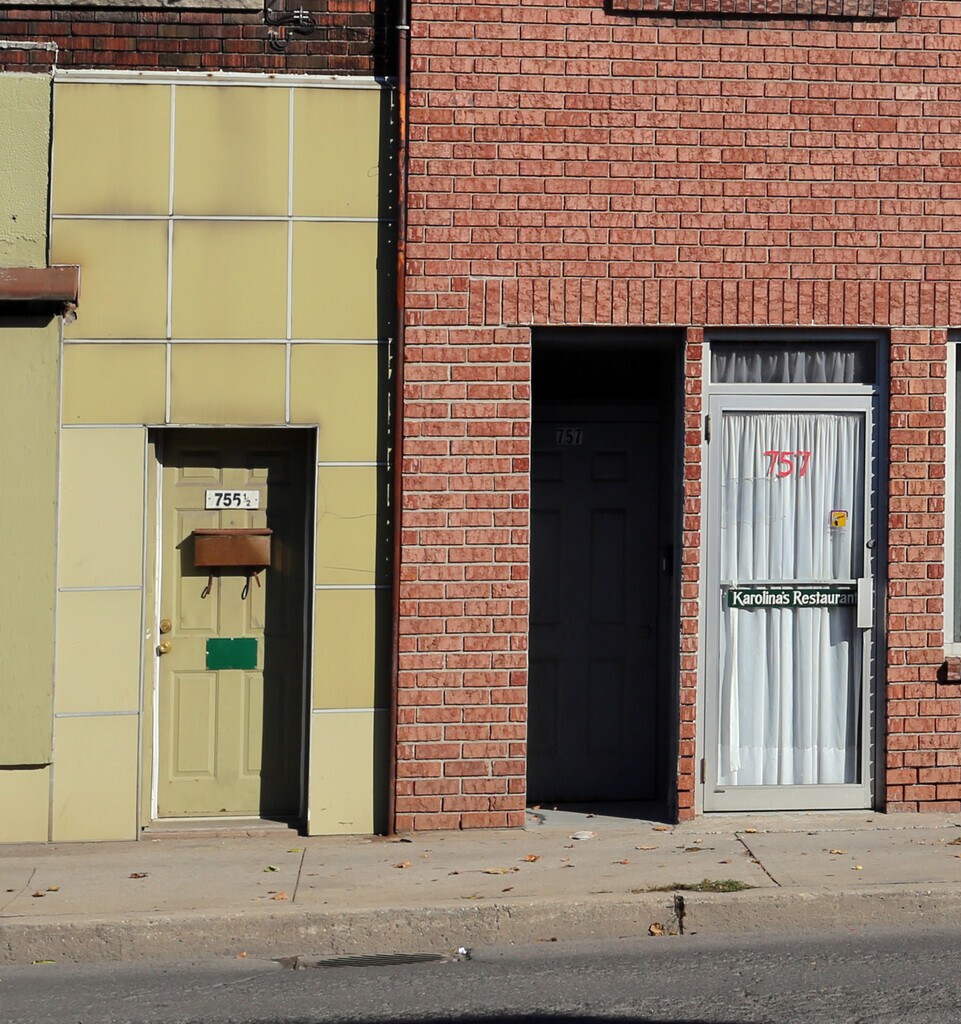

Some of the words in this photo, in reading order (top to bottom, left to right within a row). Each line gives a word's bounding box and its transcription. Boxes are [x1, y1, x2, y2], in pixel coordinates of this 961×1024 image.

[556, 428, 581, 444] 757
[763, 451, 811, 478] 757
[732, 590, 790, 606] Karolina's
